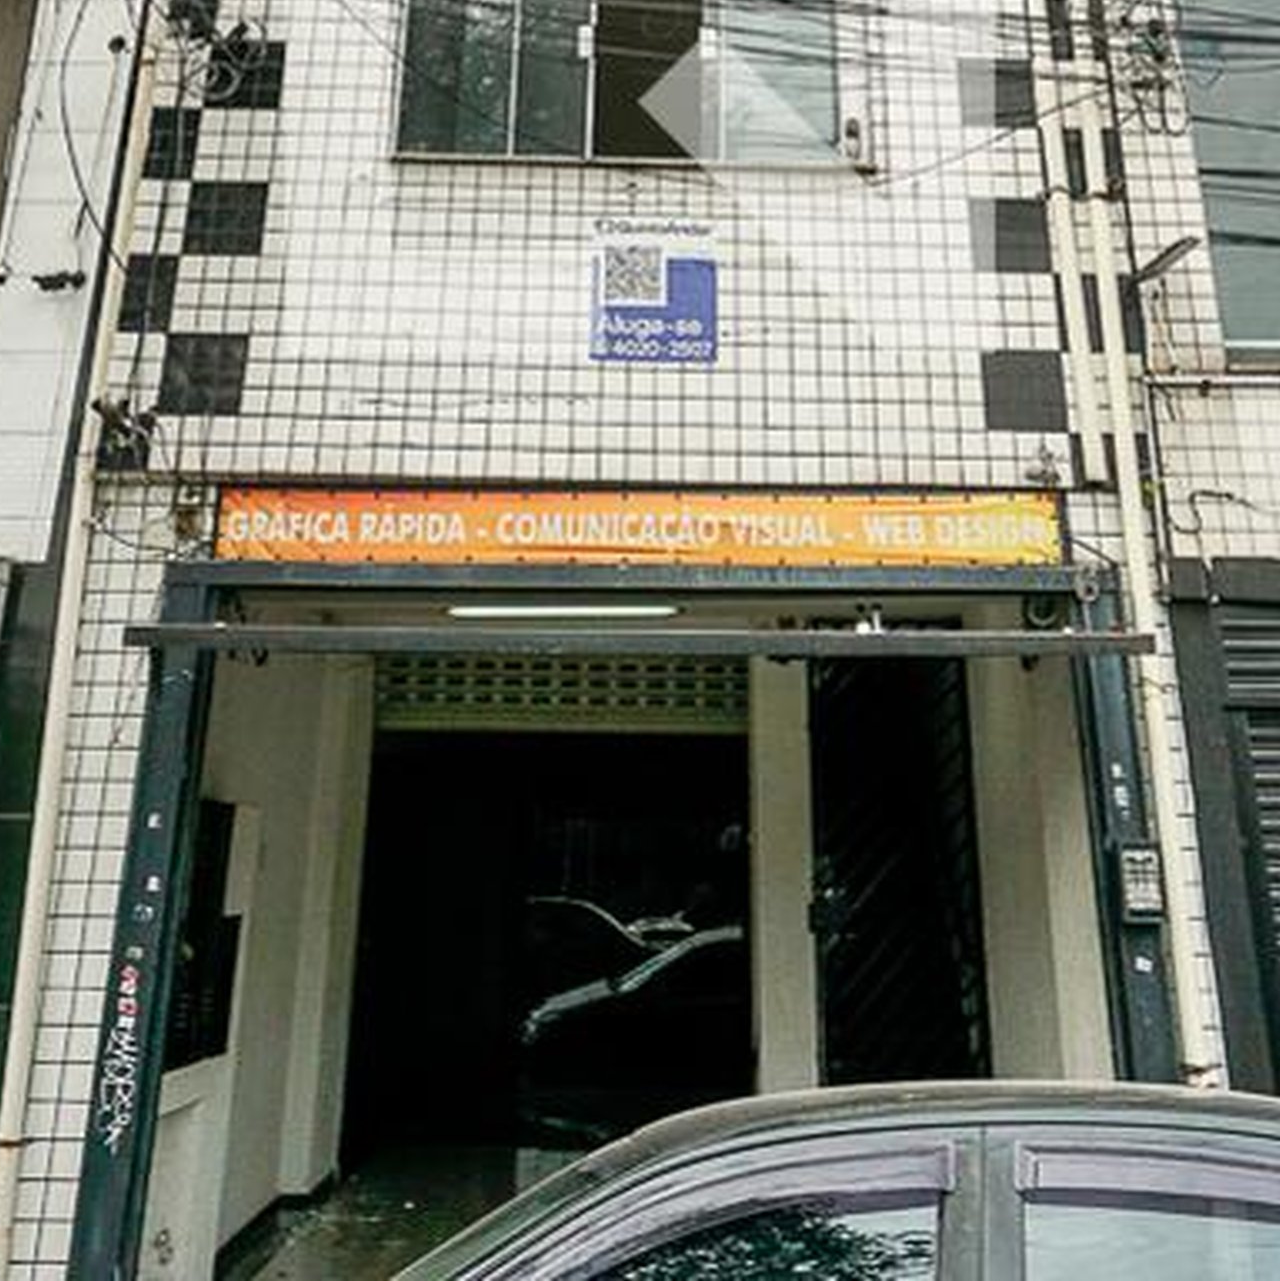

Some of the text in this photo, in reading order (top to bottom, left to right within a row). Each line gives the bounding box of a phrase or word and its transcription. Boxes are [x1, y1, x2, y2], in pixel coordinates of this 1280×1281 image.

[227, 502, 350, 544] GRÁFICA
[359, 503, 466, 544] RÁPIDA
[496, 504, 720, 548] COMUNICAÇÃO
[730, 513, 834, 546] VISUAL
[863, 514, 926, 546] WEB
